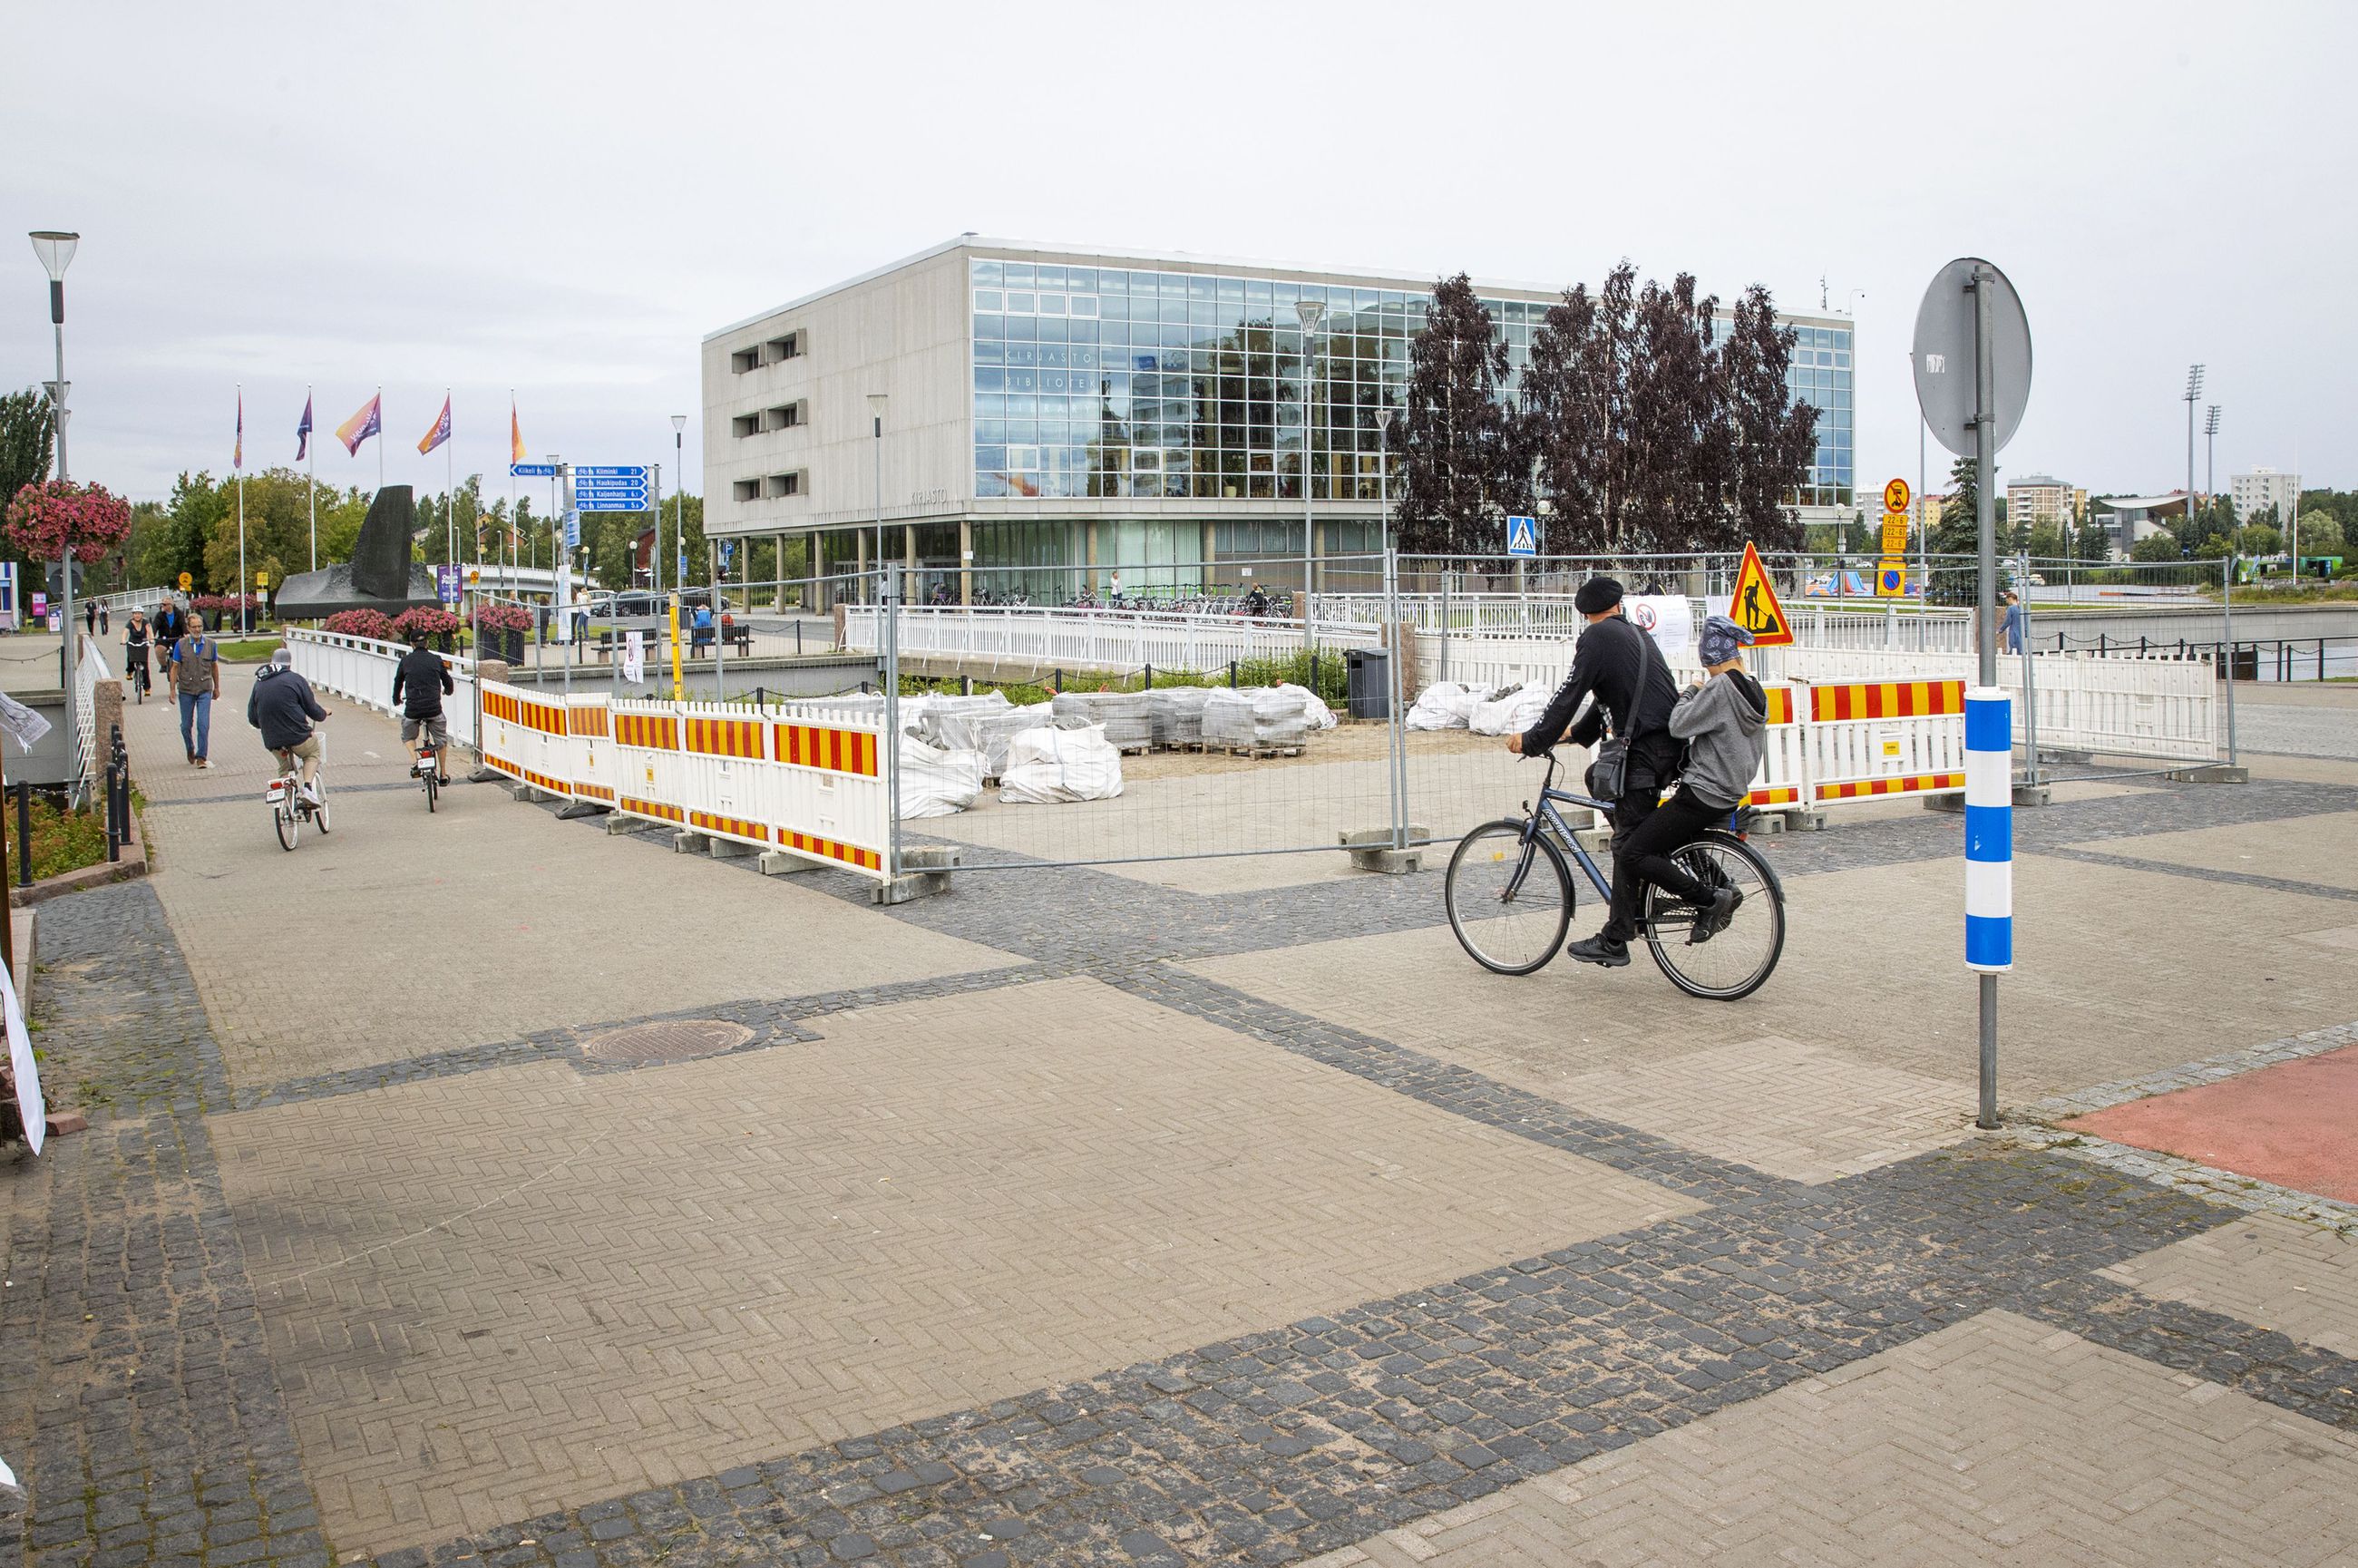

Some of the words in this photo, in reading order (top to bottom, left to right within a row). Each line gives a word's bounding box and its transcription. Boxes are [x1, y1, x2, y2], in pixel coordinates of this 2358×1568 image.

[1006, 351, 1092, 364] KIRJASTO
[518, 466, 536, 474] Kiikeli
[596, 467, 619, 475] Kiiminki
[630, 467, 638, 475] 21
[596, 479, 628, 488] Haukipudas
[596, 491, 627, 499] Kaijonharju
[911, 488, 948, 507] KIRJASTO
[726, 544, 733, 553] P
[1543, 808, 1582, 853] MADISON
